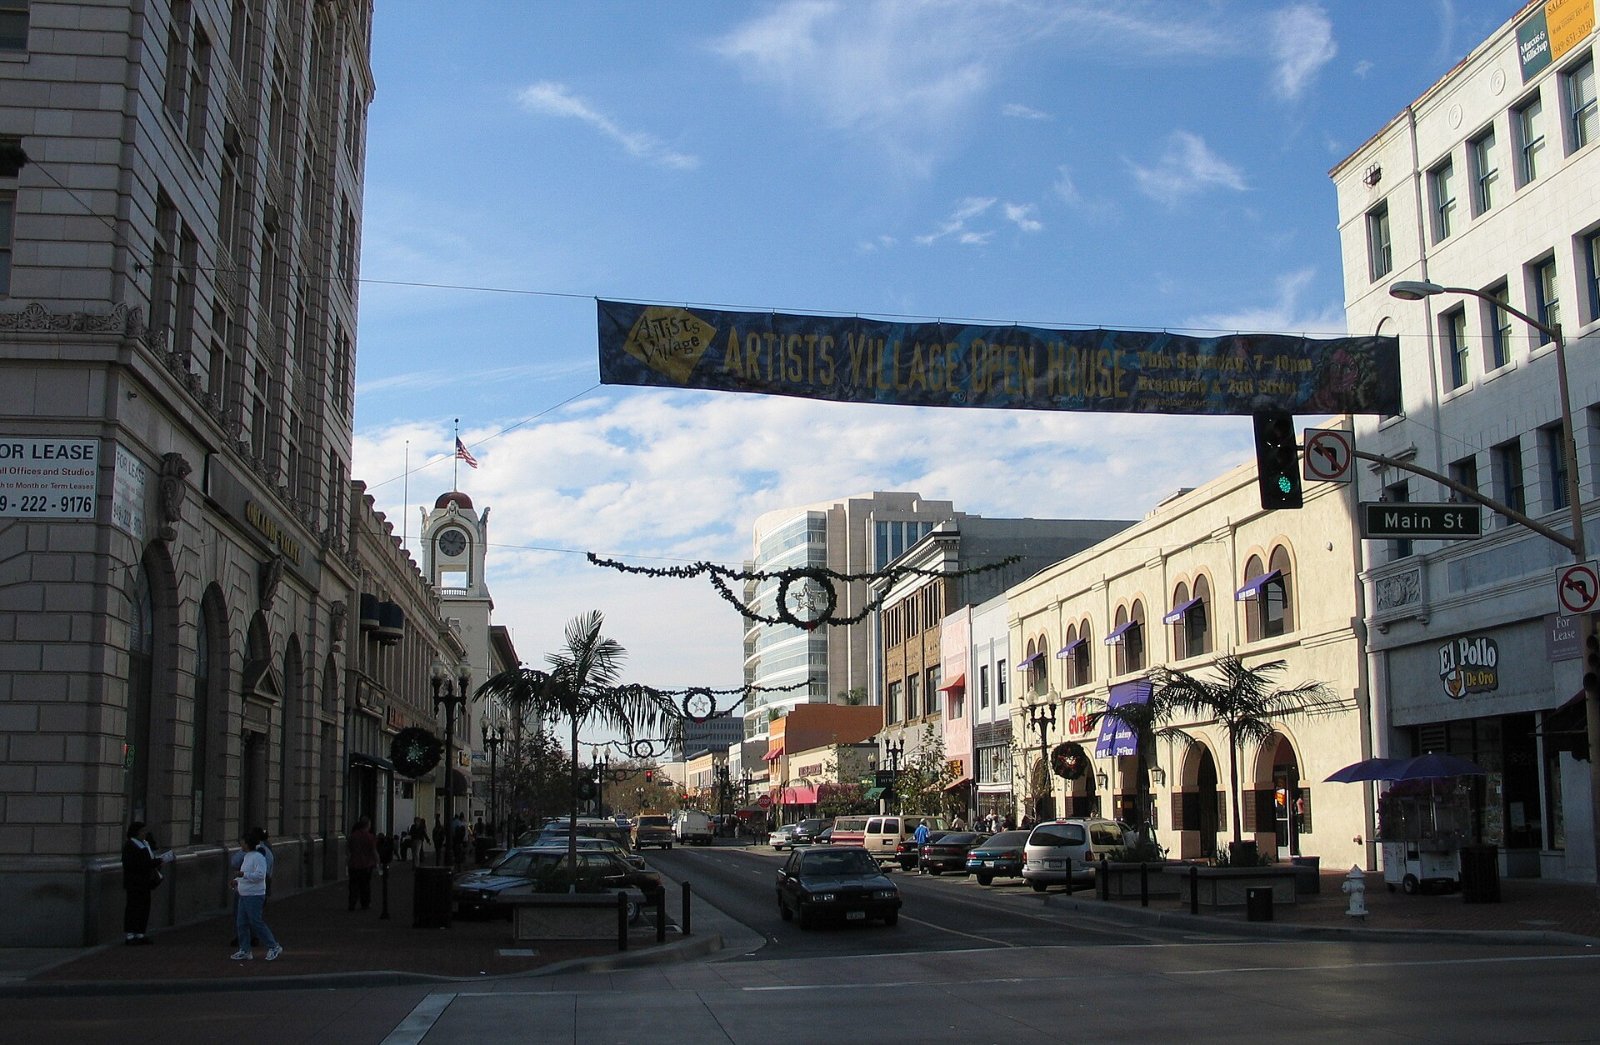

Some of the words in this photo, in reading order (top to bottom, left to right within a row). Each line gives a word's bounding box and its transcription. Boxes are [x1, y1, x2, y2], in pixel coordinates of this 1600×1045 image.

[638, 336, 700, 363] Village
[722, 326, 835, 385] ARTISTS
[847, 331, 961, 393] VILLAGE
[971, 338, 1035, 397] OPEN
[1047, 341, 1129, 398] HOUSE
[1137, 351, 1172, 368] This
[1137, 375, 1207, 397] Broadway
[32, 445, 94, 460] LEASE
[9, 467, 41, 475] Offices
[62, 468, 94, 476] Studios
[117, 451, 128, 471] FOR
[128, 460, 145, 486] LEASE
[21, 496, 47, 512] 222
[61, 496, 92, 512] 9176
[1384, 512, 1431, 528] Main
[1443, 512, 1463, 529] St
[1555, 616, 1570, 629] For
[1552, 630, 1575, 642] Lease
[1439, 641, 1456, 675] El
[1458, 637, 1496, 667] Pollo
[1467, 672, 1477, 687] De
[1478, 671, 1493, 685] Oro
